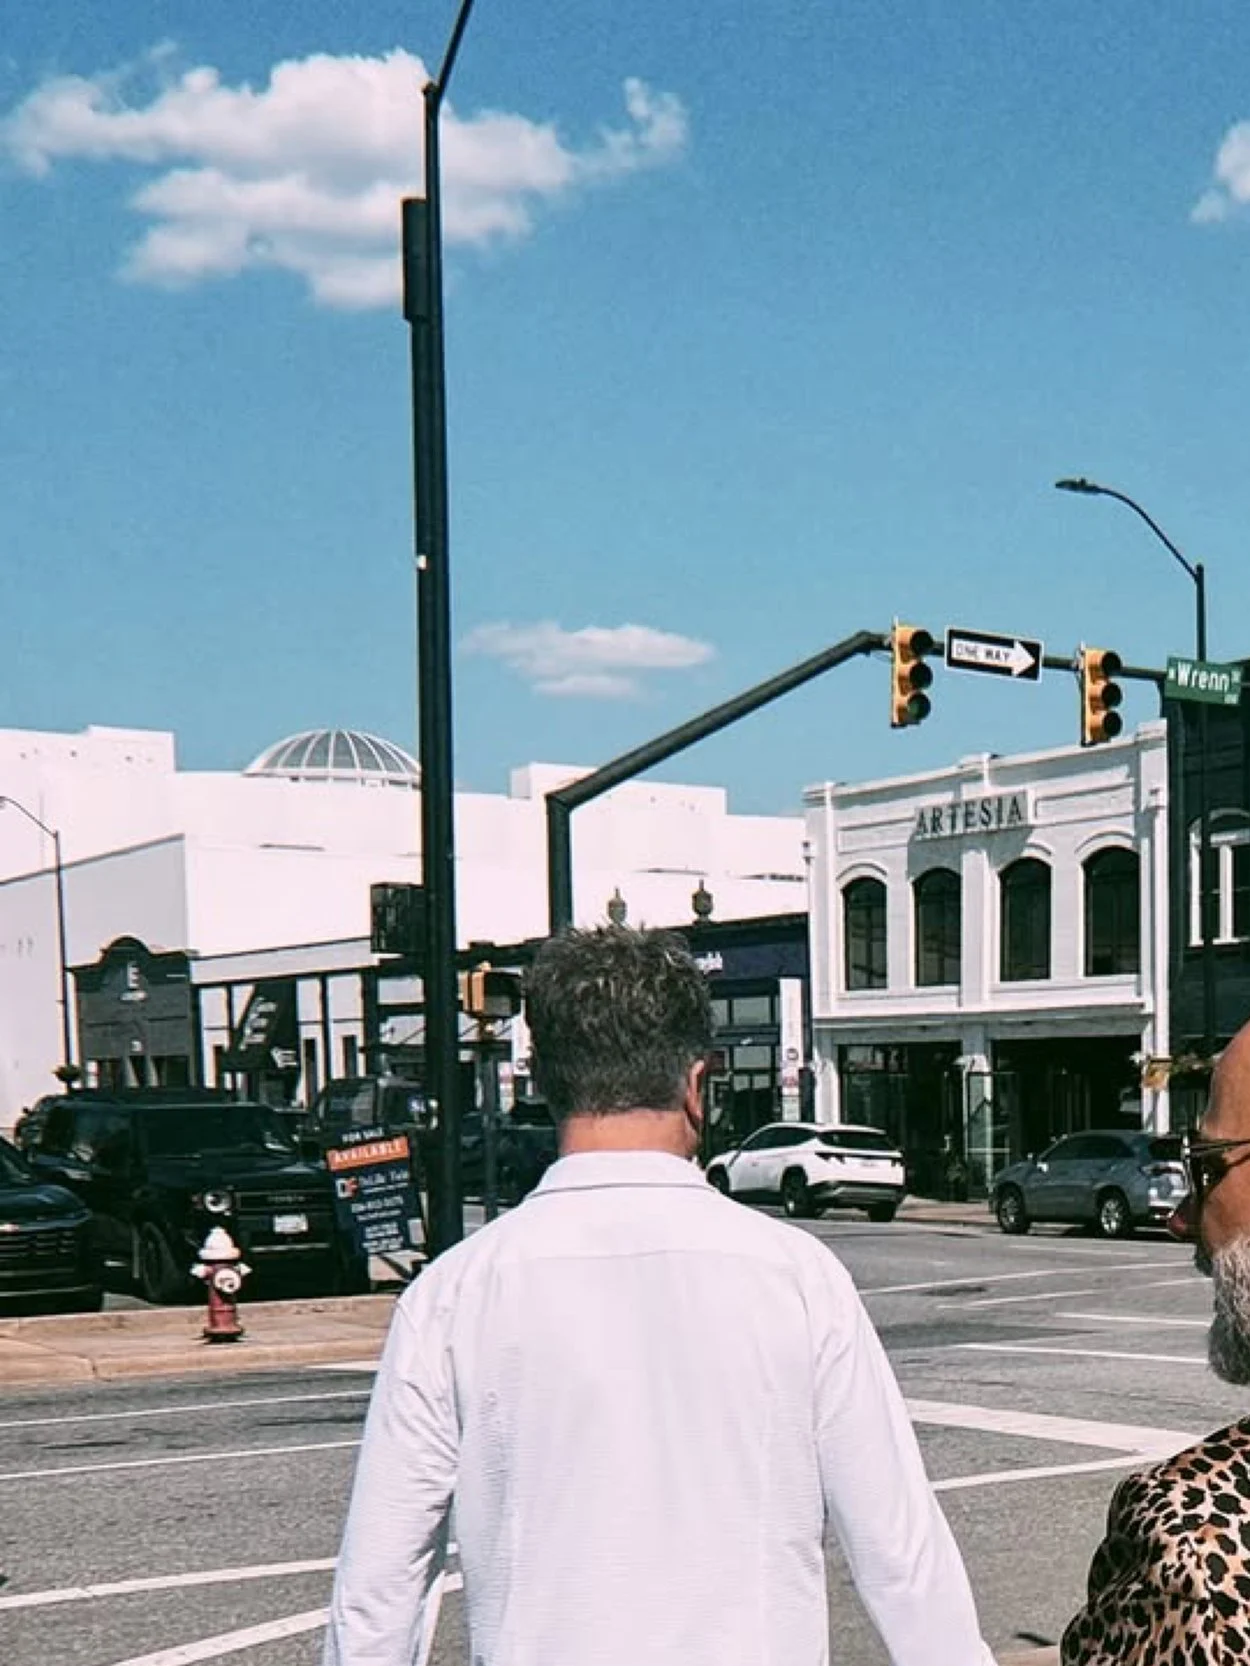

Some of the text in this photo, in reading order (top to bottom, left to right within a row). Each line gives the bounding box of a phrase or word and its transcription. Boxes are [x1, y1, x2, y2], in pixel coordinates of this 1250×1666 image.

[956, 643, 1011, 662] ONE WAY
[1178, 661, 1230, 692] Wrenn
[916, 795, 1022, 834] ARTESIA
